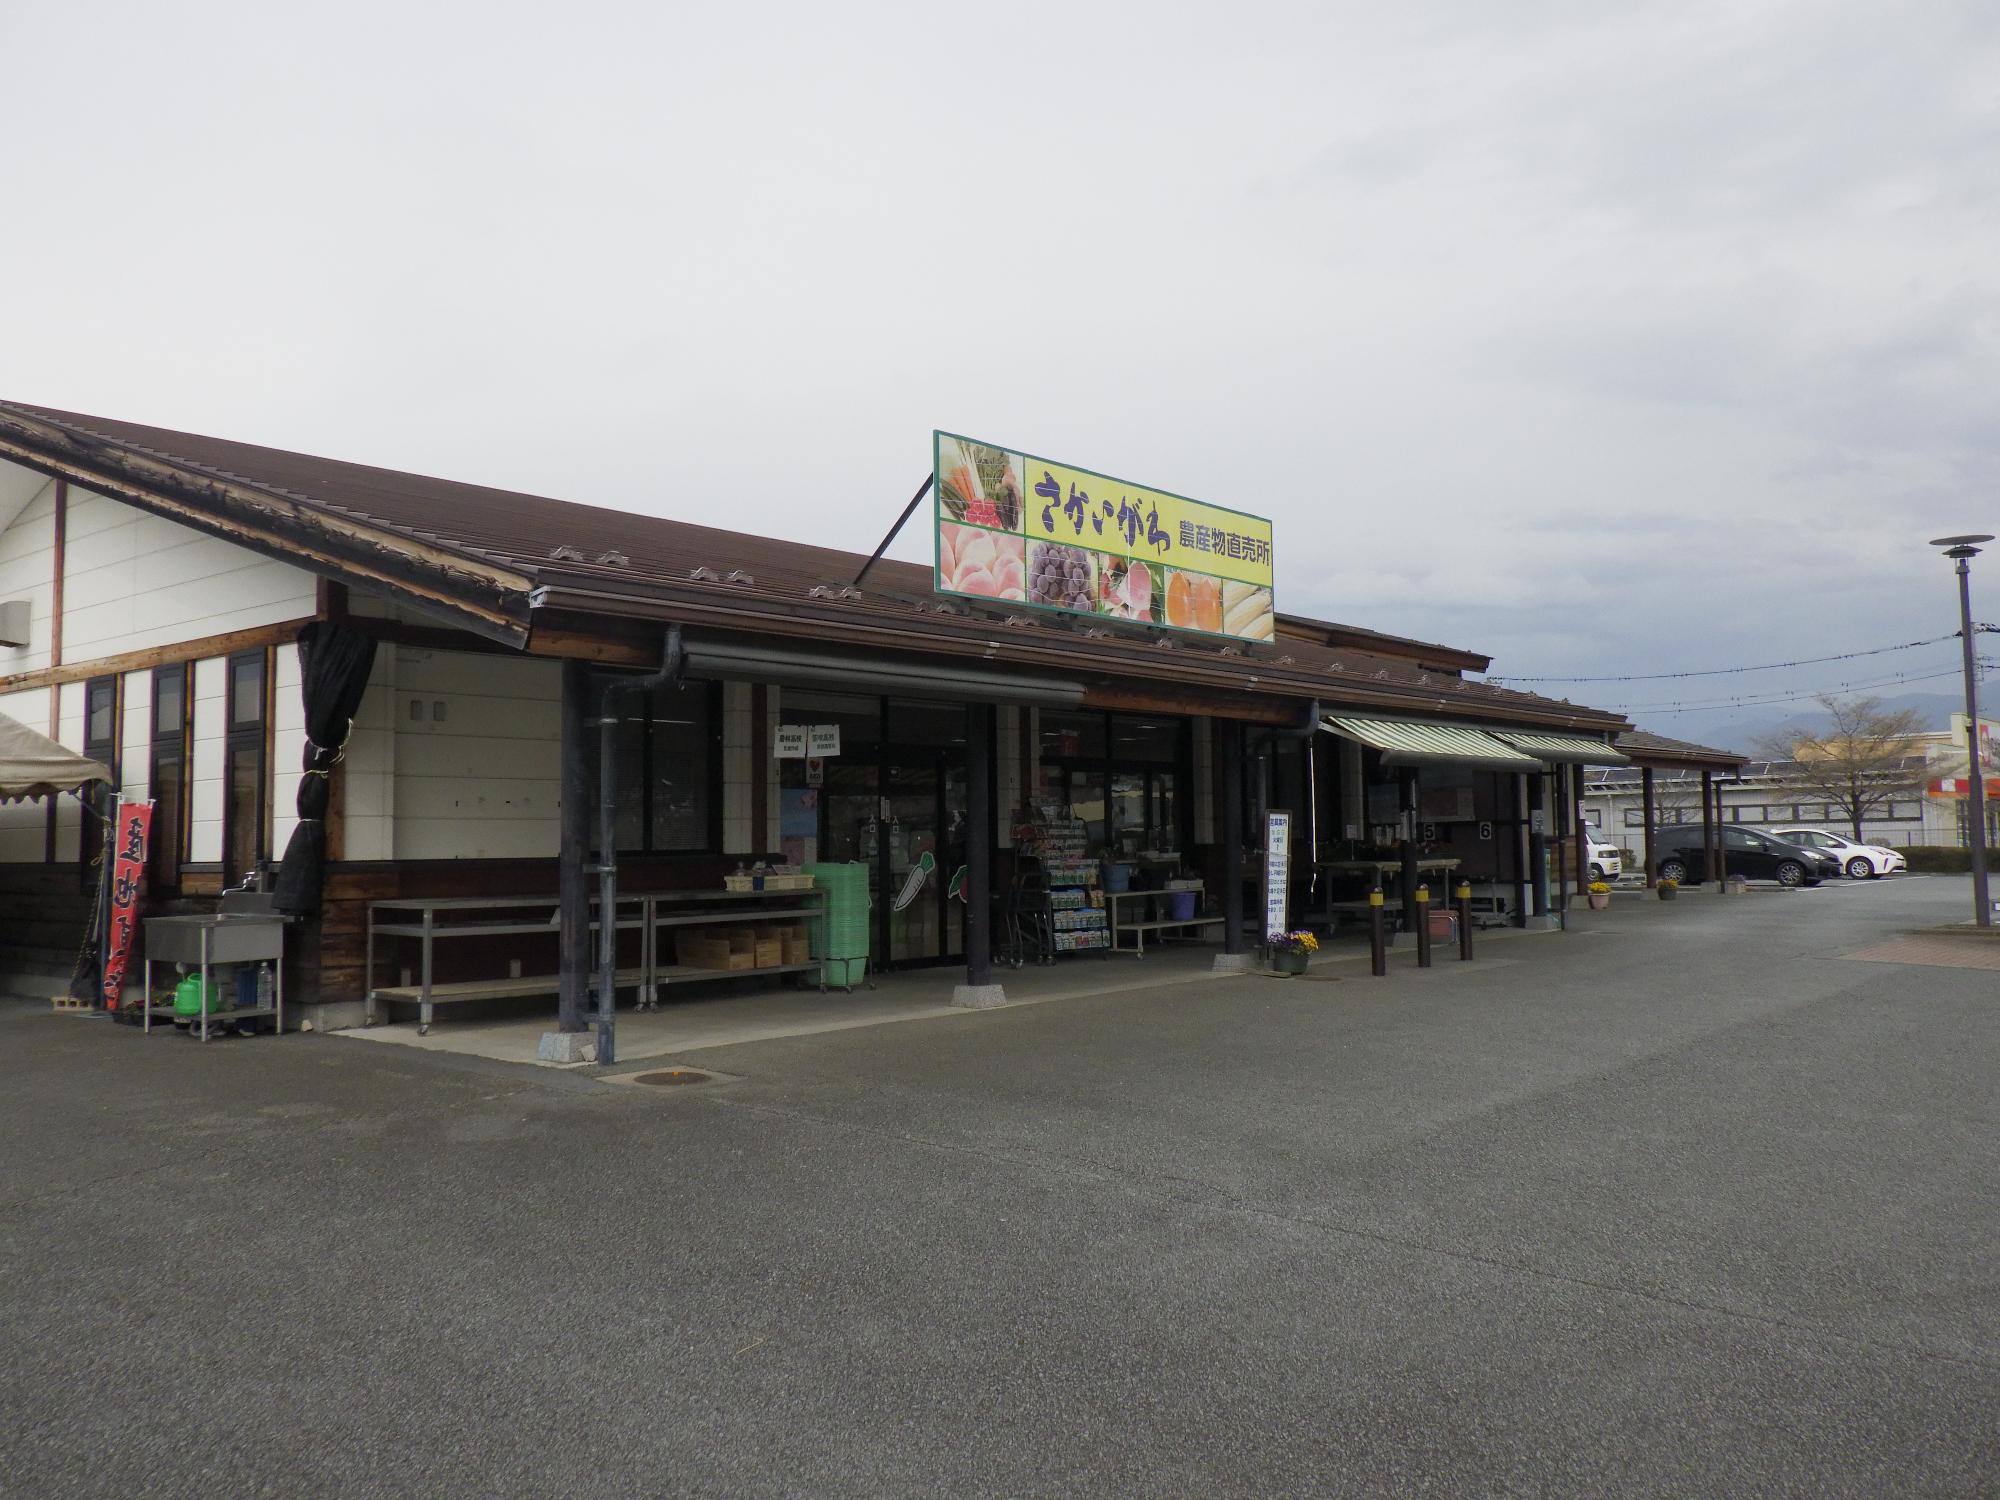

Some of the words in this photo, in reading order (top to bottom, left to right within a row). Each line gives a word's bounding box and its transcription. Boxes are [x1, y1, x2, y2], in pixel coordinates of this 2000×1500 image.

[1034, 471, 1171, 556] さかいがわ
[1179, 519, 1271, 567] 農産物直売所
[1425, 824, 1434, 839] 5
[1481, 824, 1490, 838] 6
